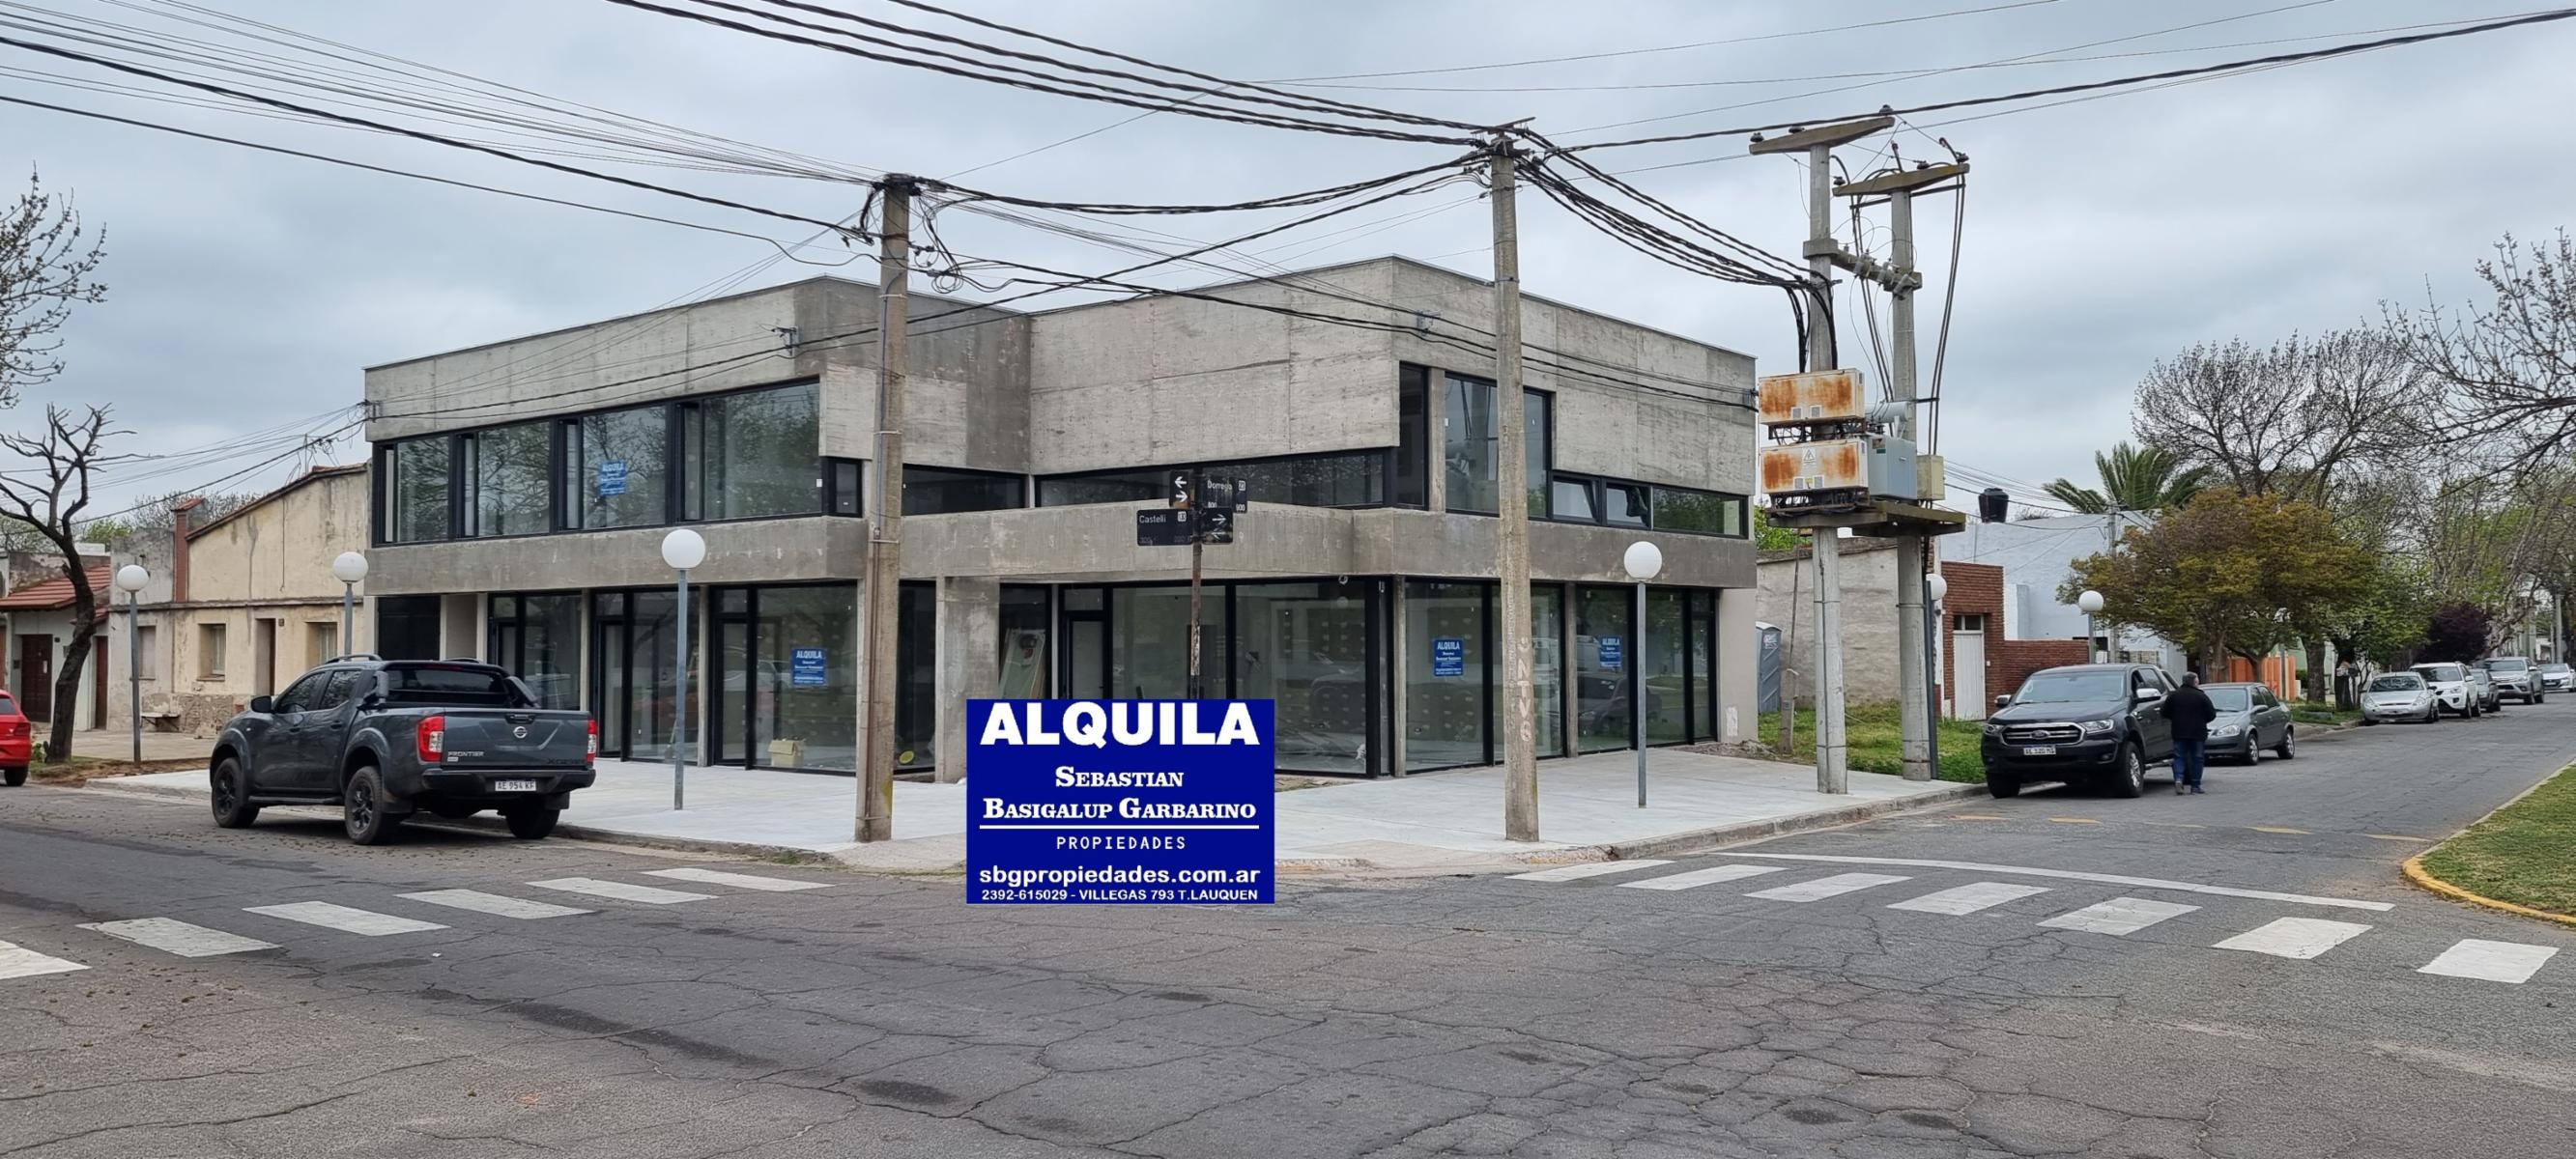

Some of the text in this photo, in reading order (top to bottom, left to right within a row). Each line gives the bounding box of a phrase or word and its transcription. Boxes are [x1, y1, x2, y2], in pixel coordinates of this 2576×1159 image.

[1207, 479, 1233, 492] Dorrego
[1139, 514, 1166, 523] Castelli
[1437, 641, 1460, 650] ALQUILA
[796, 650, 822, 659] ALQUILA
